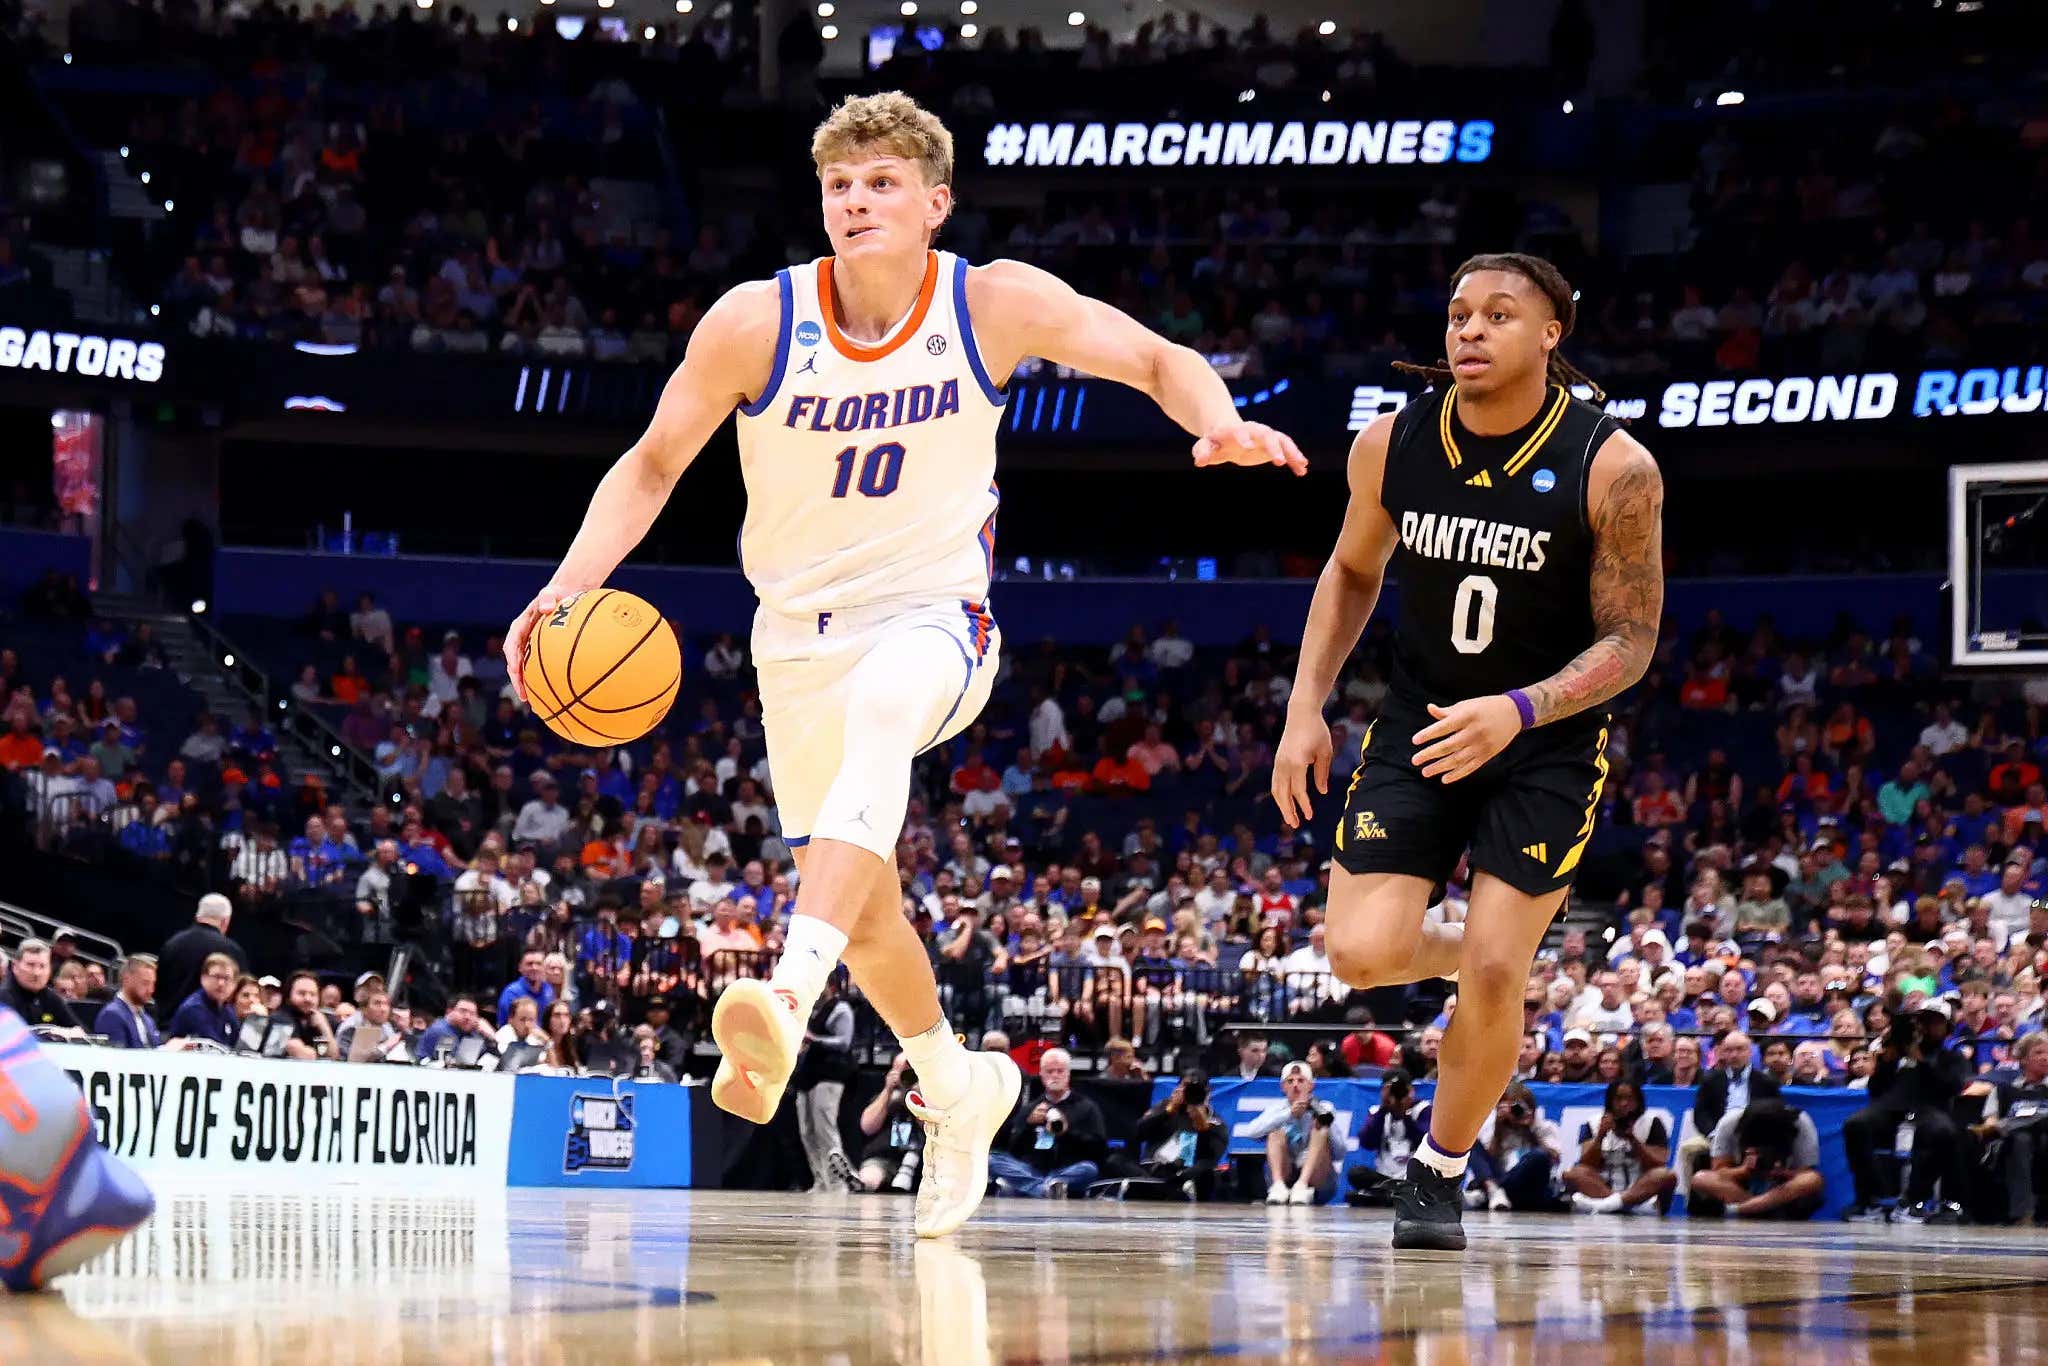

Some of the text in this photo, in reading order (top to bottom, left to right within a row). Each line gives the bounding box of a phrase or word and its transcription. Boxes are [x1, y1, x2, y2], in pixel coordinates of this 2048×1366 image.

[984, 120, 1495, 166] #MARCHMADNESS
[0, 326, 166, 382] GATORS
[927, 335, 946, 355] SEC
[783, 378, 960, 432] FLORIDA
[1659, 373, 1899, 428] SECOND
[831, 442, 906, 498] 10
[1401, 511, 1551, 571] PANTHERS
[818, 612, 832, 635] F
[1451, 575, 1498, 654] 0
[64, 1069, 476, 1166] SITY OF SOUTH FLORIDA
